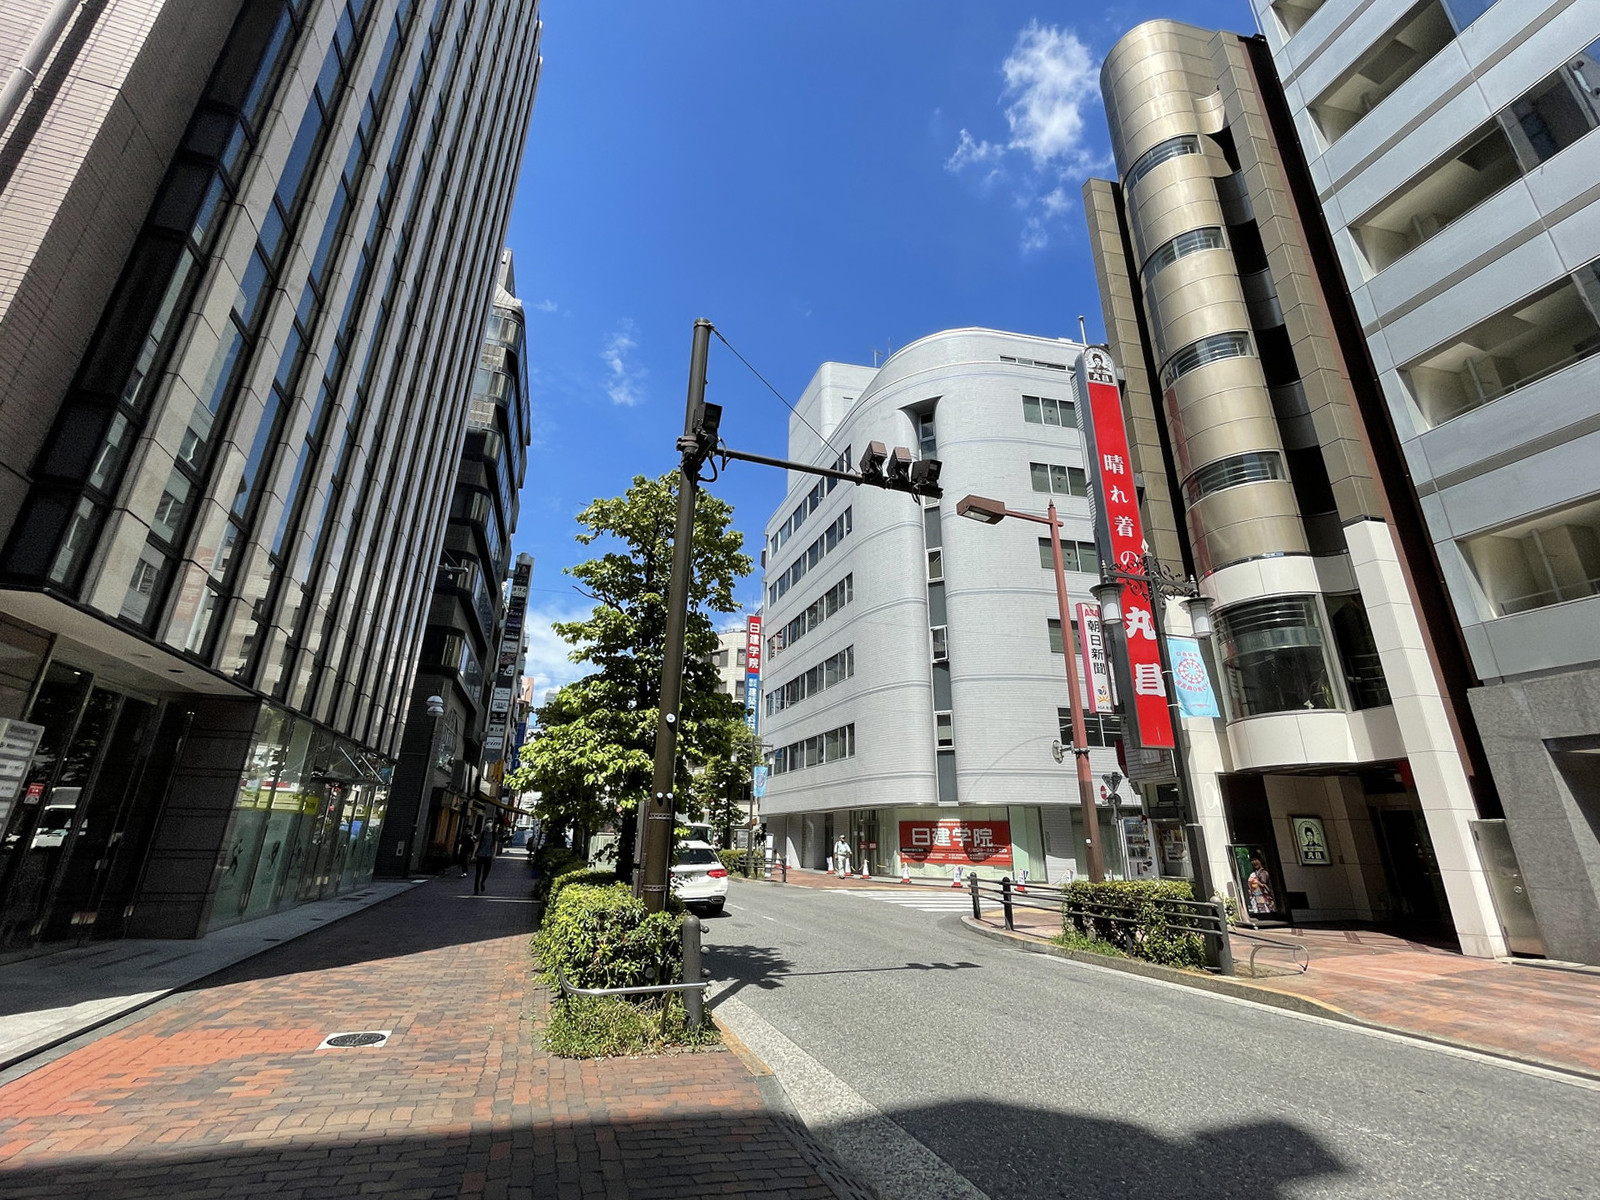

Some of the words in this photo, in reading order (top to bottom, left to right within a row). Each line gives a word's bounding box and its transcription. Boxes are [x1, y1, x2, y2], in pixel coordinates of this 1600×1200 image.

[748, 623, 760, 668] 日建学院
[1087, 620, 1106, 675] 朝日新聞
[912, 827, 993, 847] 日建学院
